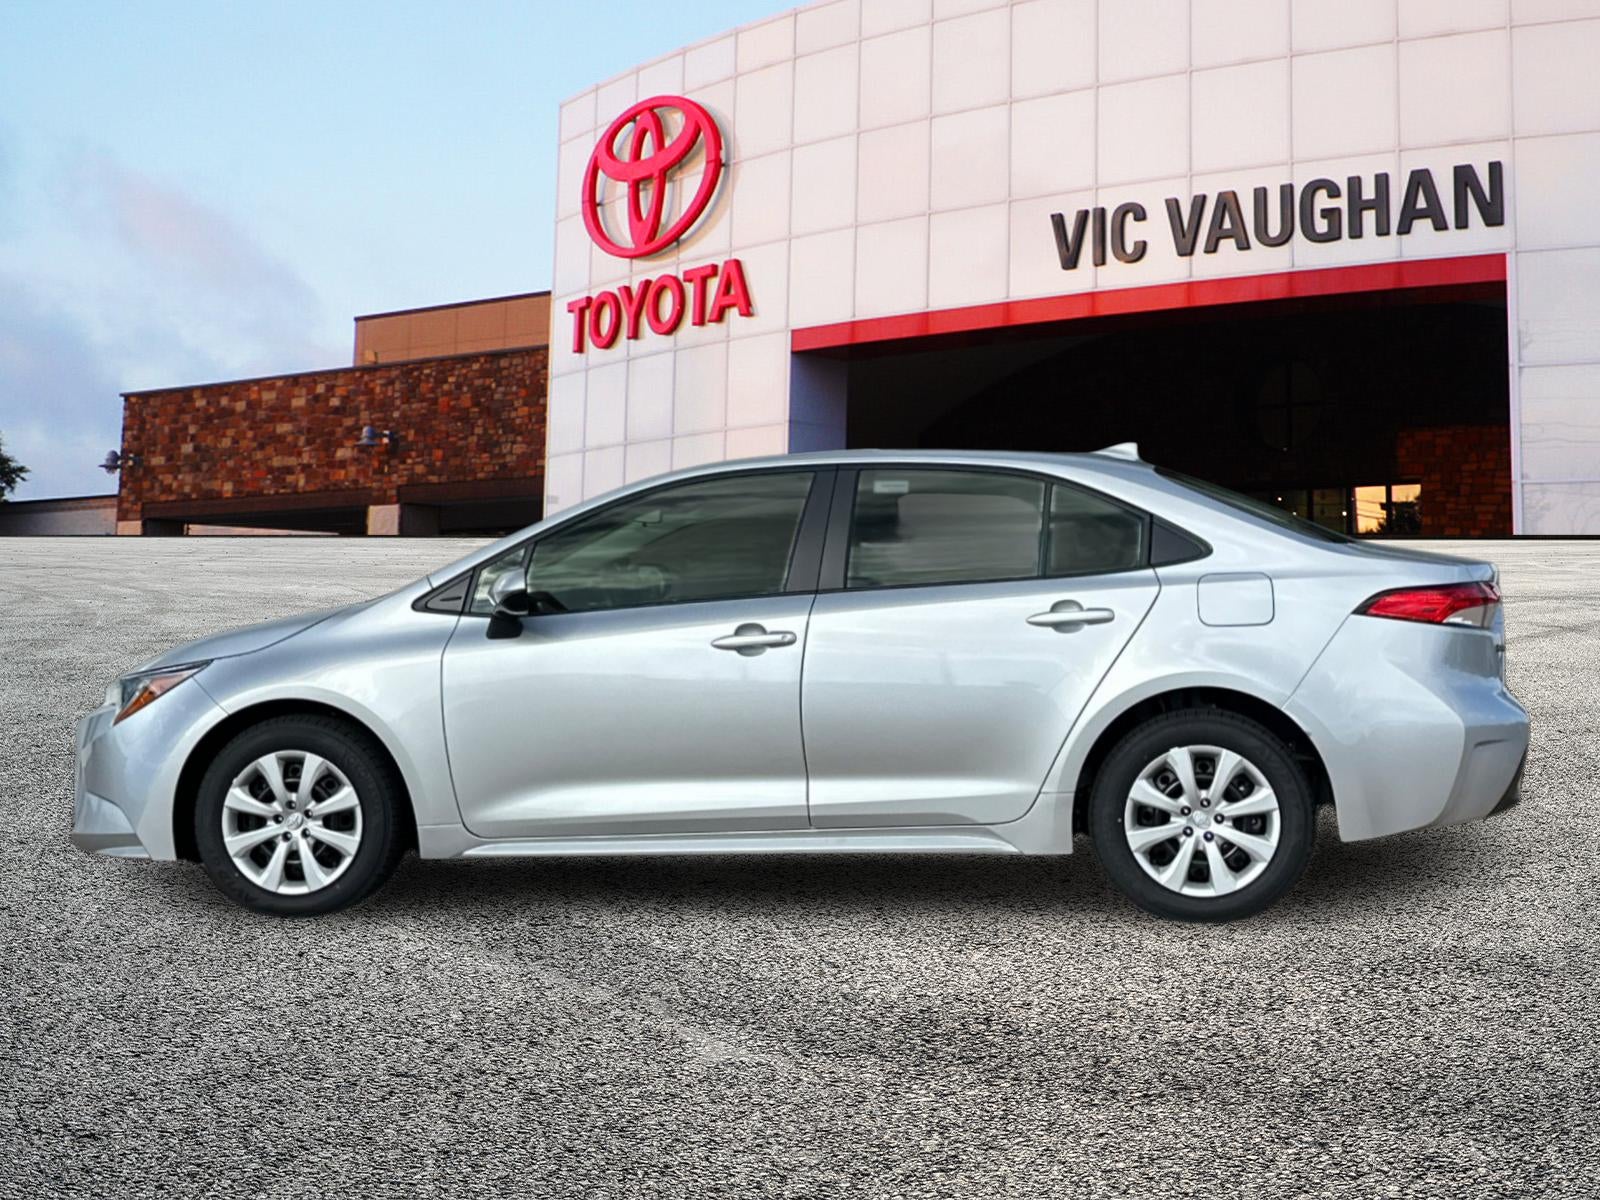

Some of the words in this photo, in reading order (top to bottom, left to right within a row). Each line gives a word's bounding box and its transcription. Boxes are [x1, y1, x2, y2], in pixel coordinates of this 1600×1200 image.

[1050, 202, 1147, 270] VIC
[1165, 160, 1505, 257] VAUGHAN
[567, 258, 754, 354] TOYOTA
